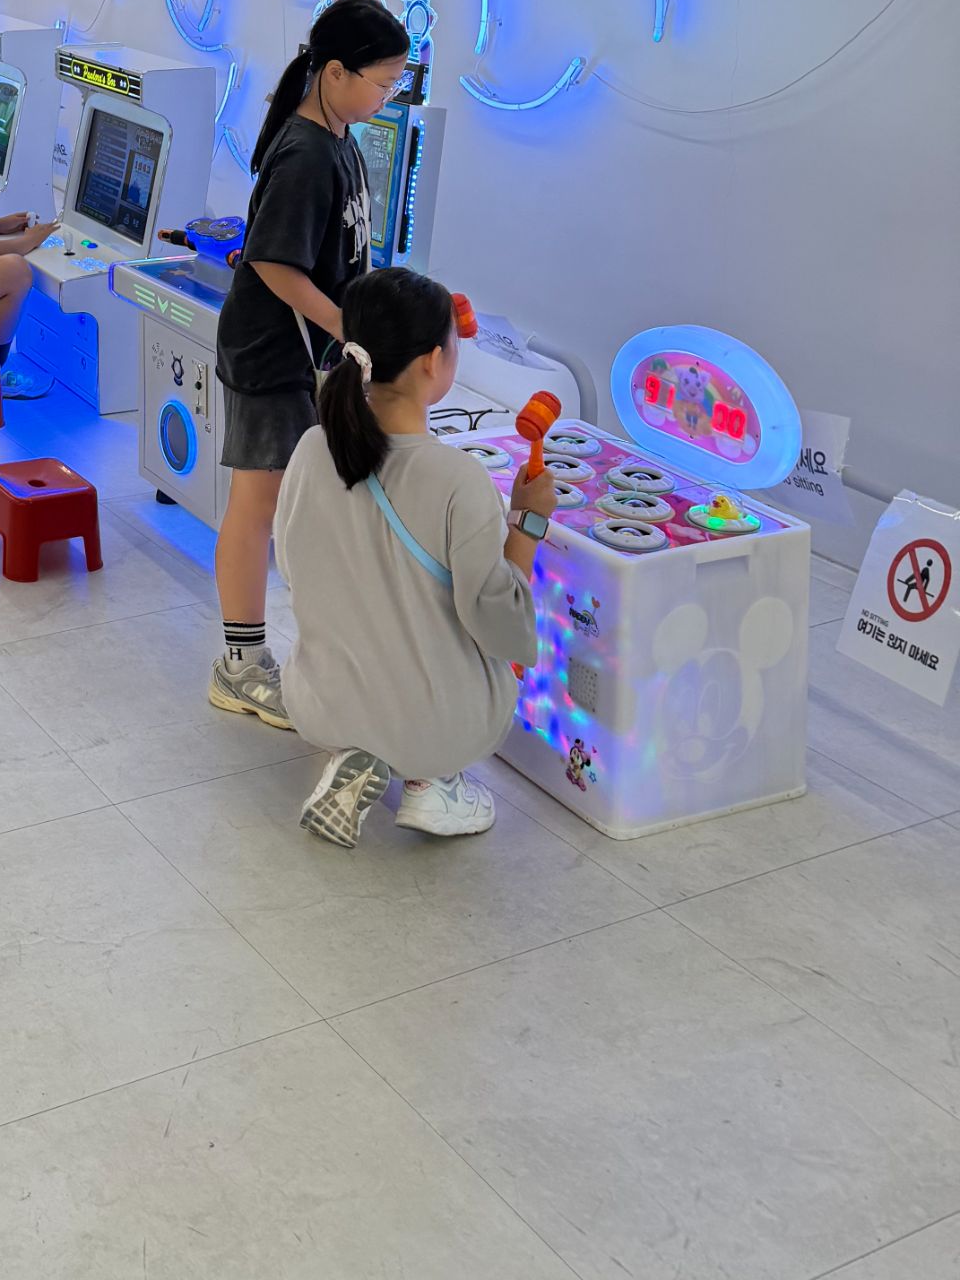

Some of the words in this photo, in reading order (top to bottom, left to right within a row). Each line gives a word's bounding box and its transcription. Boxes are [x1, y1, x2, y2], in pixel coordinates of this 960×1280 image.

[796, 448, 828, 476] 세요
[792, 475, 825, 496] sitting
[228, 647, 243, 661] H
[857, 618, 886, 644] 여기는
[887, 633, 908, 655] 앉지
[908, 644, 940, 671] 마세요
[251, 685, 273, 702] N
